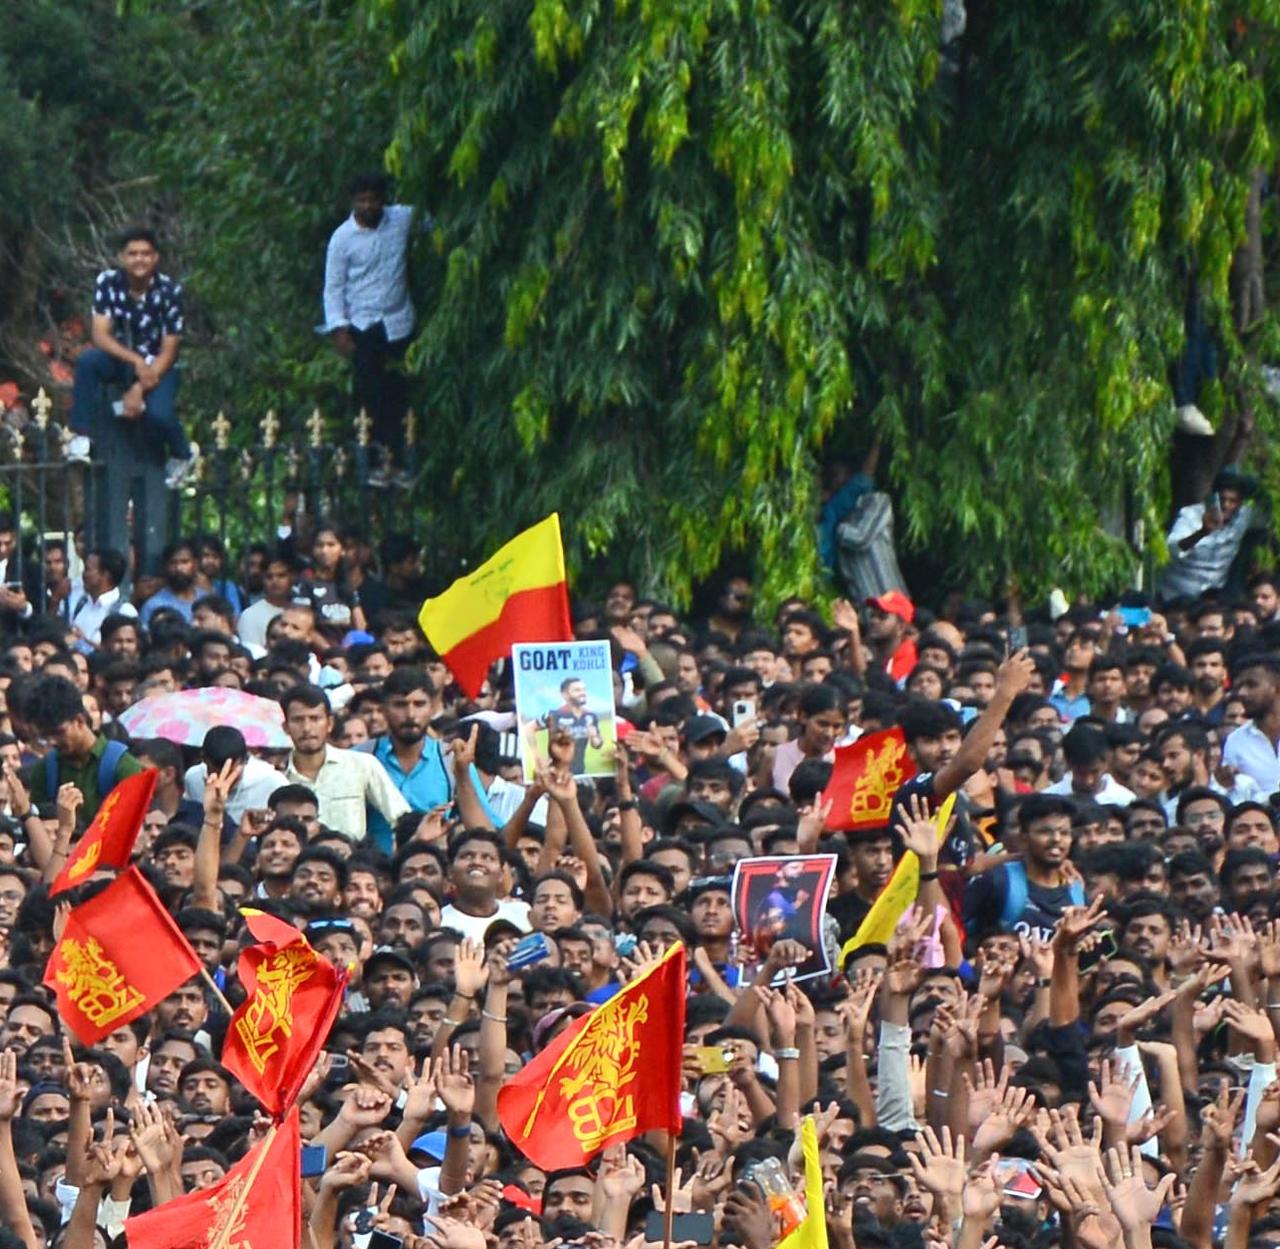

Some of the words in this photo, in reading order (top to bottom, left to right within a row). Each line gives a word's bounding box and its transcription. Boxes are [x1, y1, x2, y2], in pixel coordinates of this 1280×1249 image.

[519, 649, 571, 671] GOAT
[578, 646, 604, 657] KING
[573, 658, 605, 671] KOHLI
